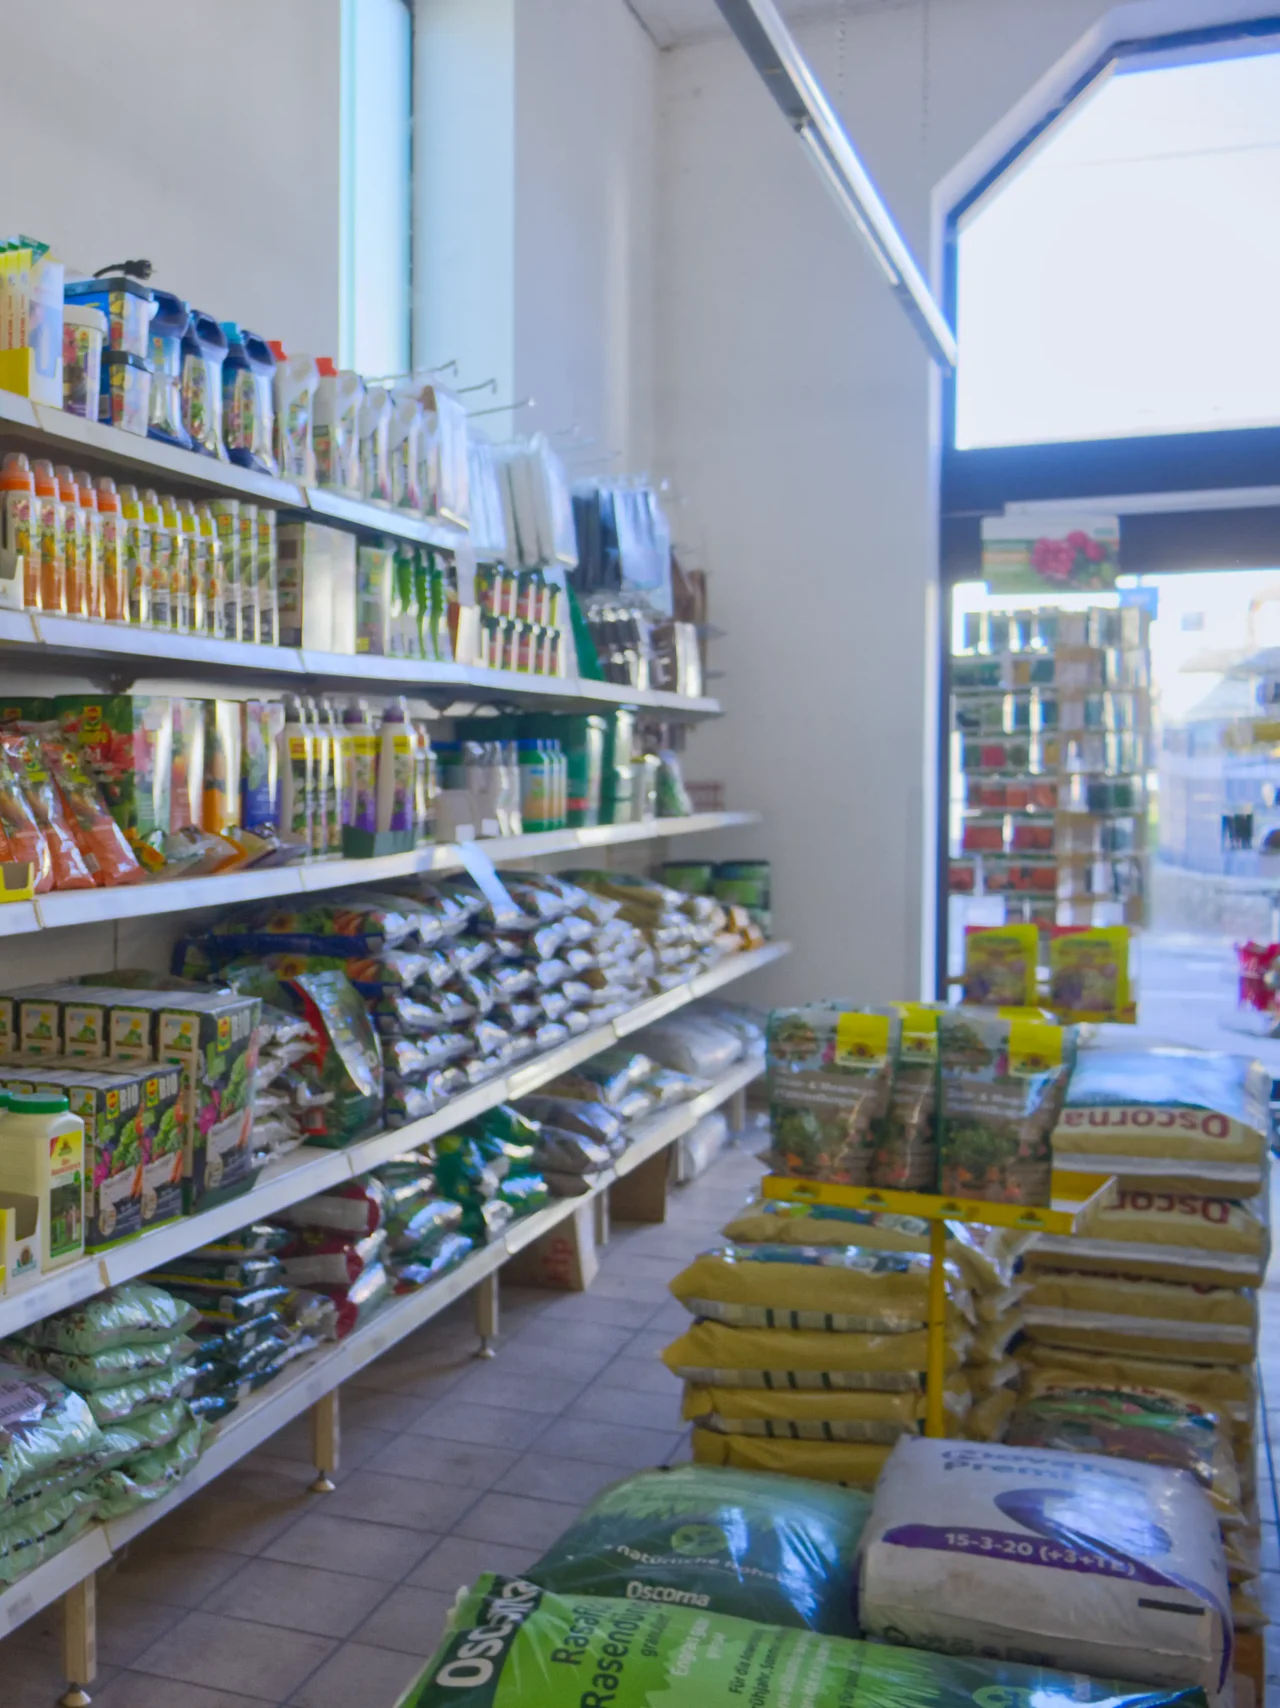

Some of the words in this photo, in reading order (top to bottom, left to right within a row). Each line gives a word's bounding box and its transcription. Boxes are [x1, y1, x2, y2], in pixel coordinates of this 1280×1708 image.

[120, 1084, 139, 1112] BIO
[159, 1073, 179, 1100] BIO
[1064, 1108, 1230, 1138] Oscorna
[944, 1533, 1033, 1556] 15-3-20
